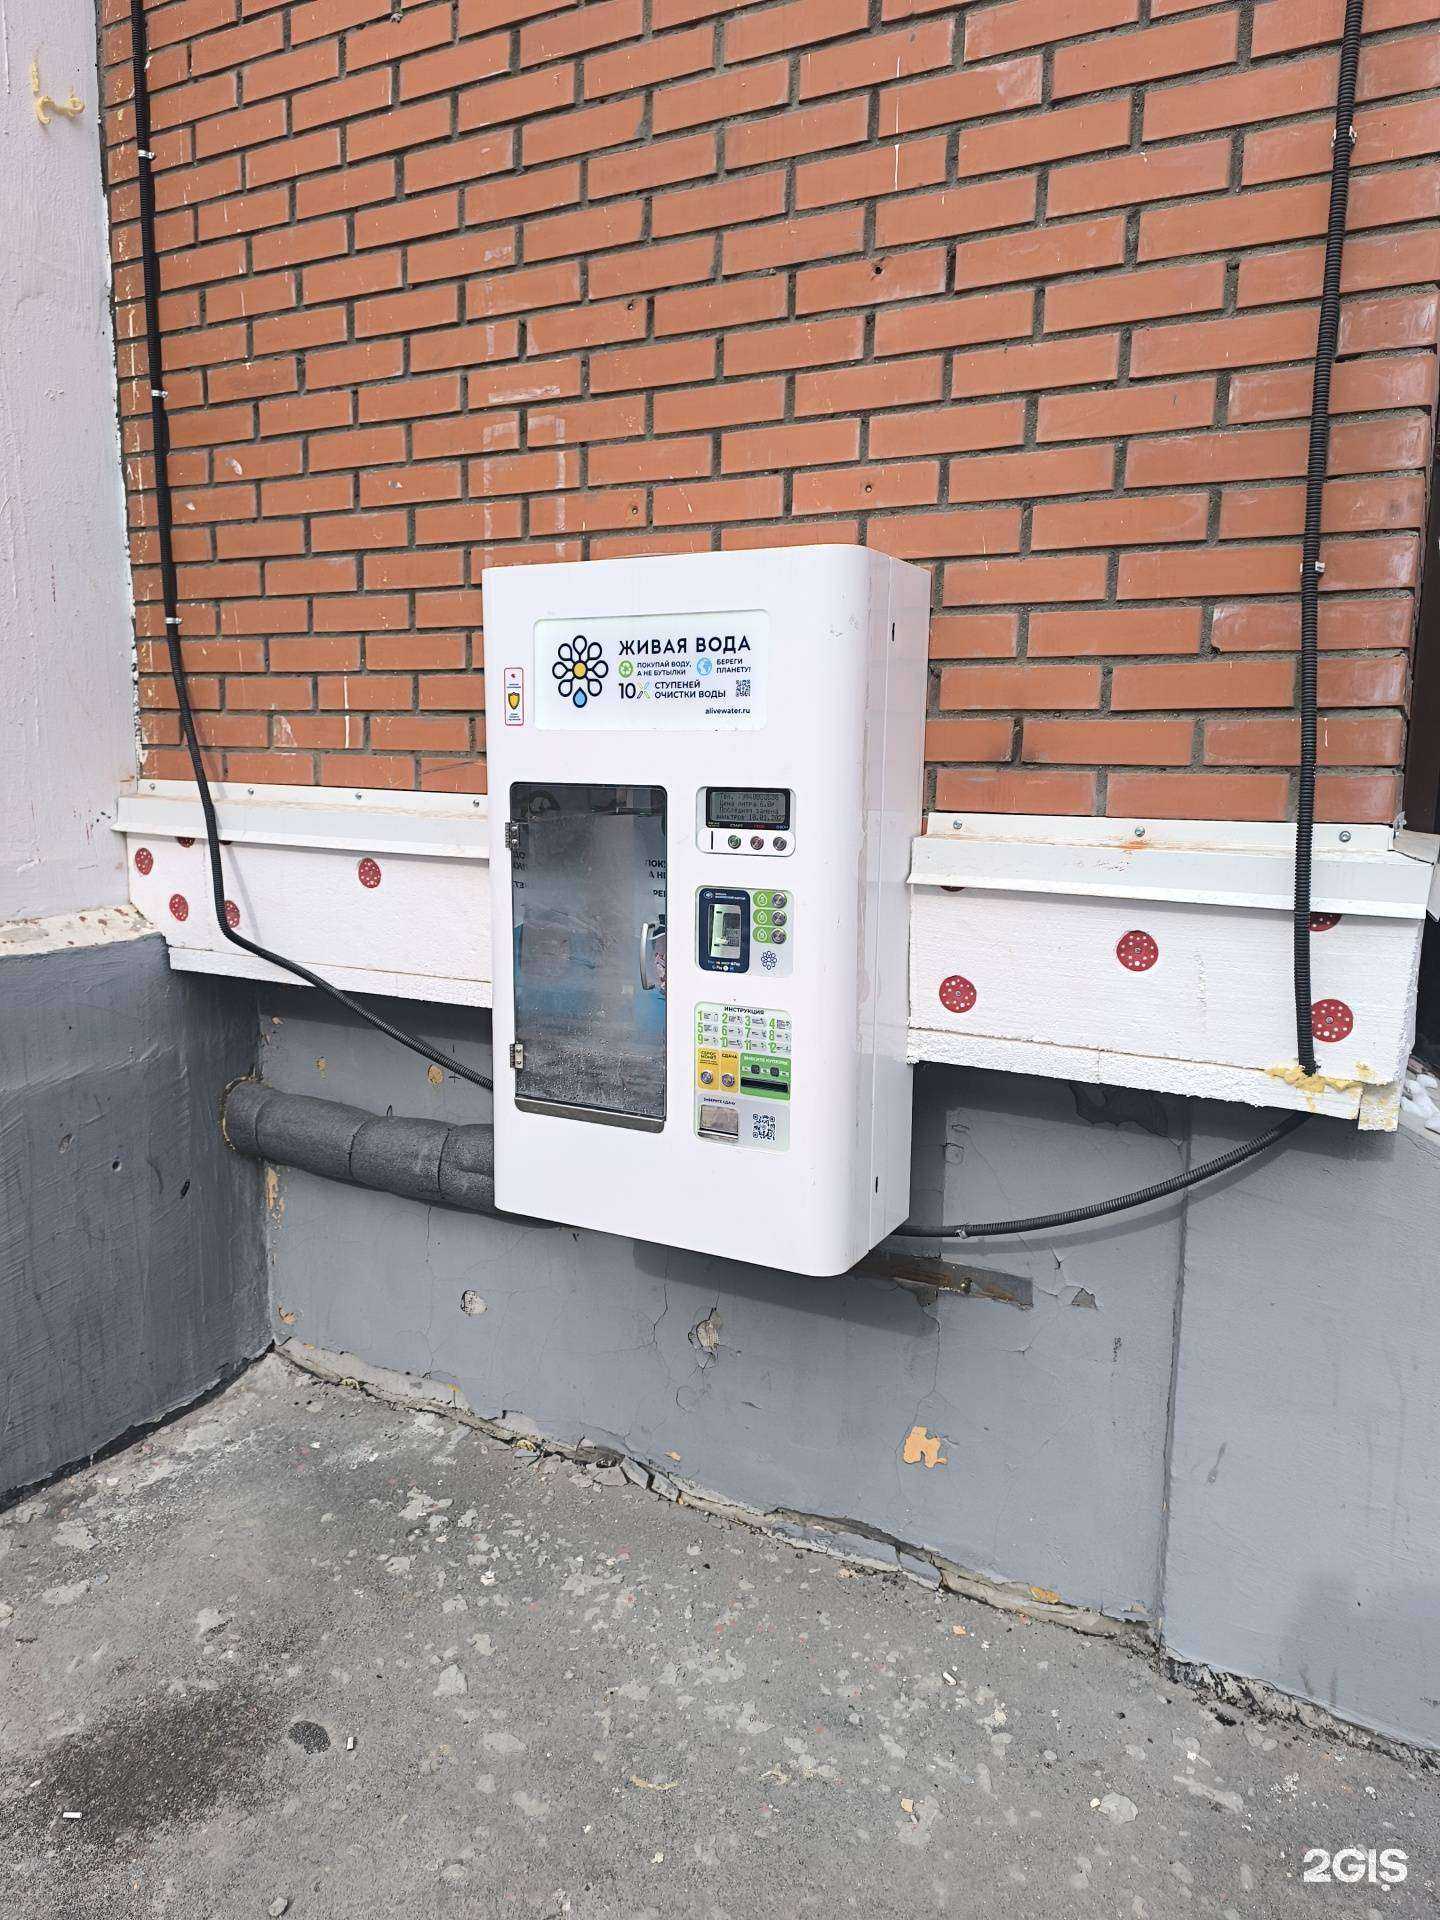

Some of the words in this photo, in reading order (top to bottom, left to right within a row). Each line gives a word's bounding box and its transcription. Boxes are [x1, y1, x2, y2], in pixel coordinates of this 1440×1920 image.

[618, 638, 687, 656] ЖИВАЯ
[696, 635, 751, 655] ВОДА
[637, 661, 670, 669] ПОКУПАЙ
[671, 660, 692, 668] ВОДУ,
[716, 658, 743, 666] БЕРЕГИ
[653, 669, 686, 677] БУТЫЛКИ
[716, 666, 752, 674] ПЛАНЕТУ!
[654, 679, 701, 690] СТУПЕНЕЙ
[654, 690, 697, 699] ОЧИСТКИ
[698, 690, 726, 699] ВОДЫ
[705, 707, 751, 715] alivewater.ru
[698, 1010, 704, 1020] 1
[724, 1006, 765, 1015] ИНСТРУКЦИЯ
[722, 1013, 728, 1024] 2
[745, 1015, 751, 1026] 3
[769, 1018, 776, 1029] 4
[698, 1023, 704, 1033] 5
[722, 1025, 728, 1036] 6
[745, 1027, 751, 1038] 7
[698, 1034, 704, 1044] 9
[769, 1029, 775, 1041] 8
